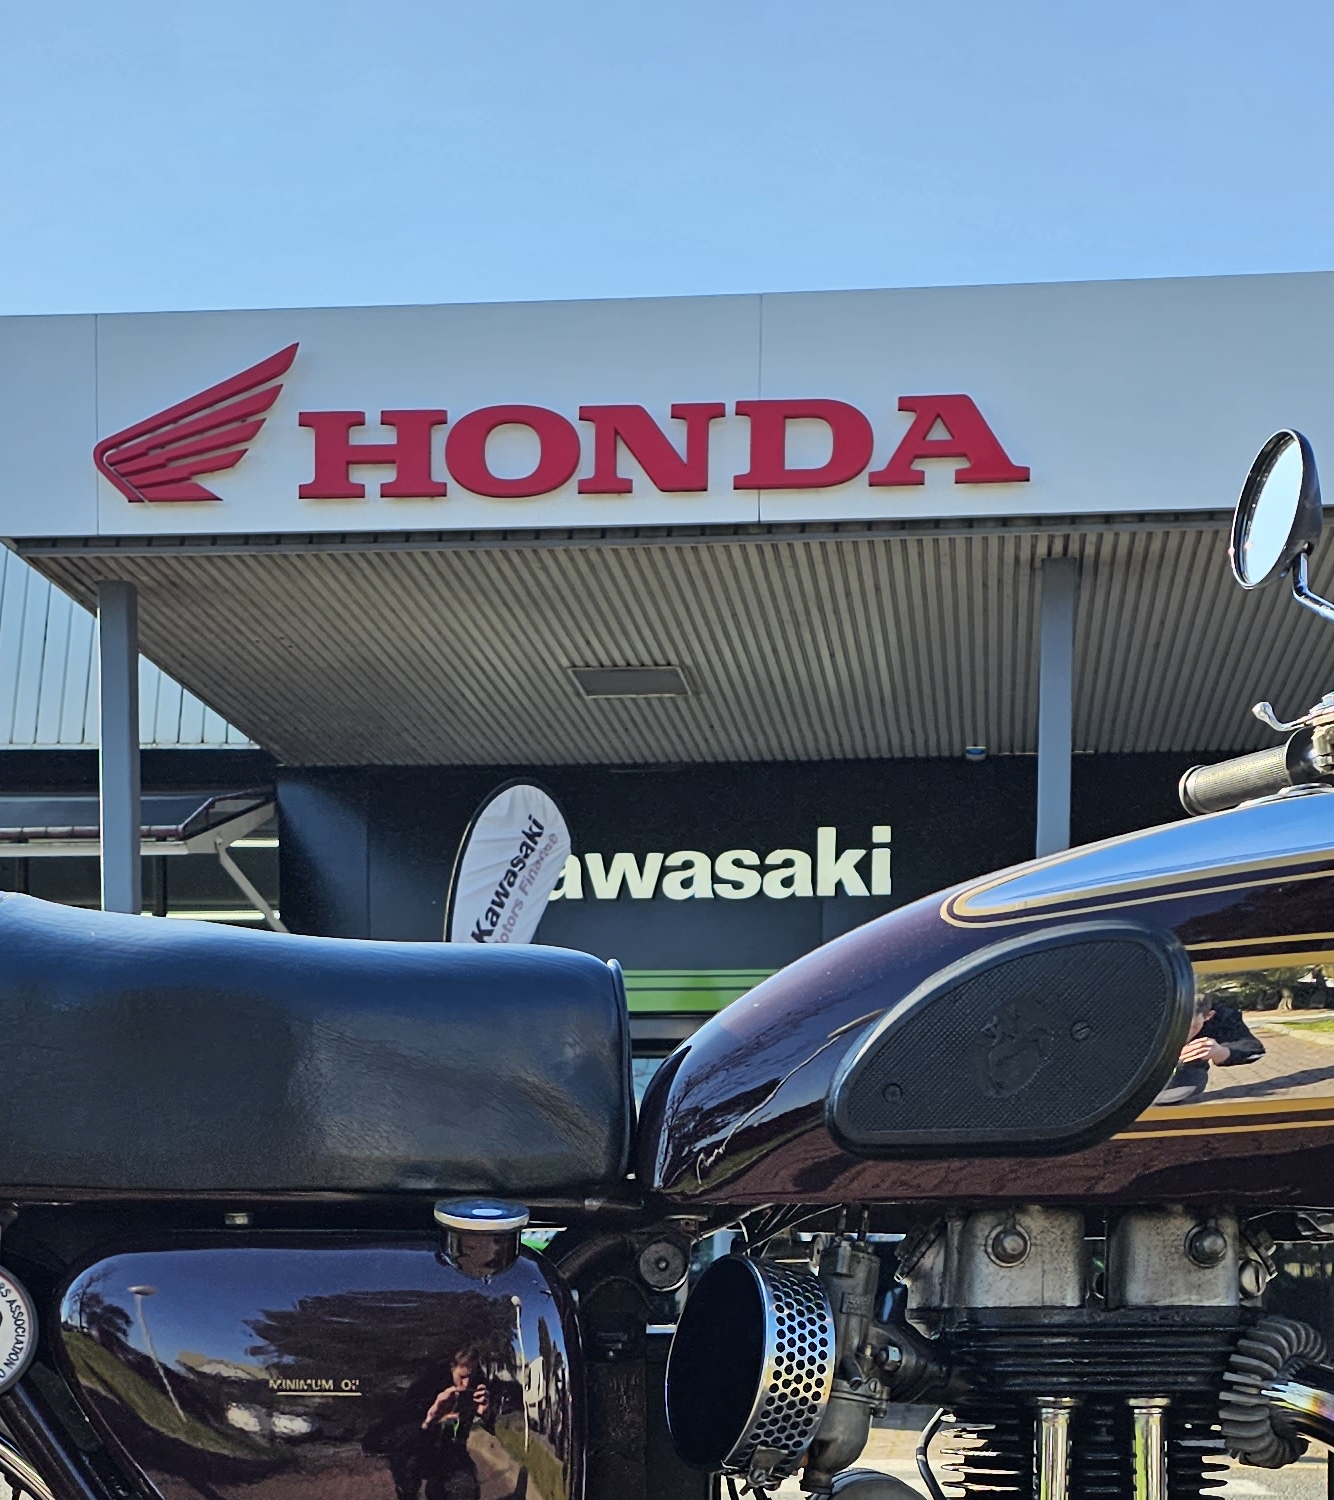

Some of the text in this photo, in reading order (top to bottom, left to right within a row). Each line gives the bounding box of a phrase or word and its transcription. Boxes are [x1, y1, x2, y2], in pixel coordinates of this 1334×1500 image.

[299, 393, 1031, 500] HONDA
[471, 814, 545, 943] Kawasaki
[548, 825, 891, 901] awasaki
[496, 897, 524, 943] otors
[4, 1299, 27, 1369] ASSOCIATION
